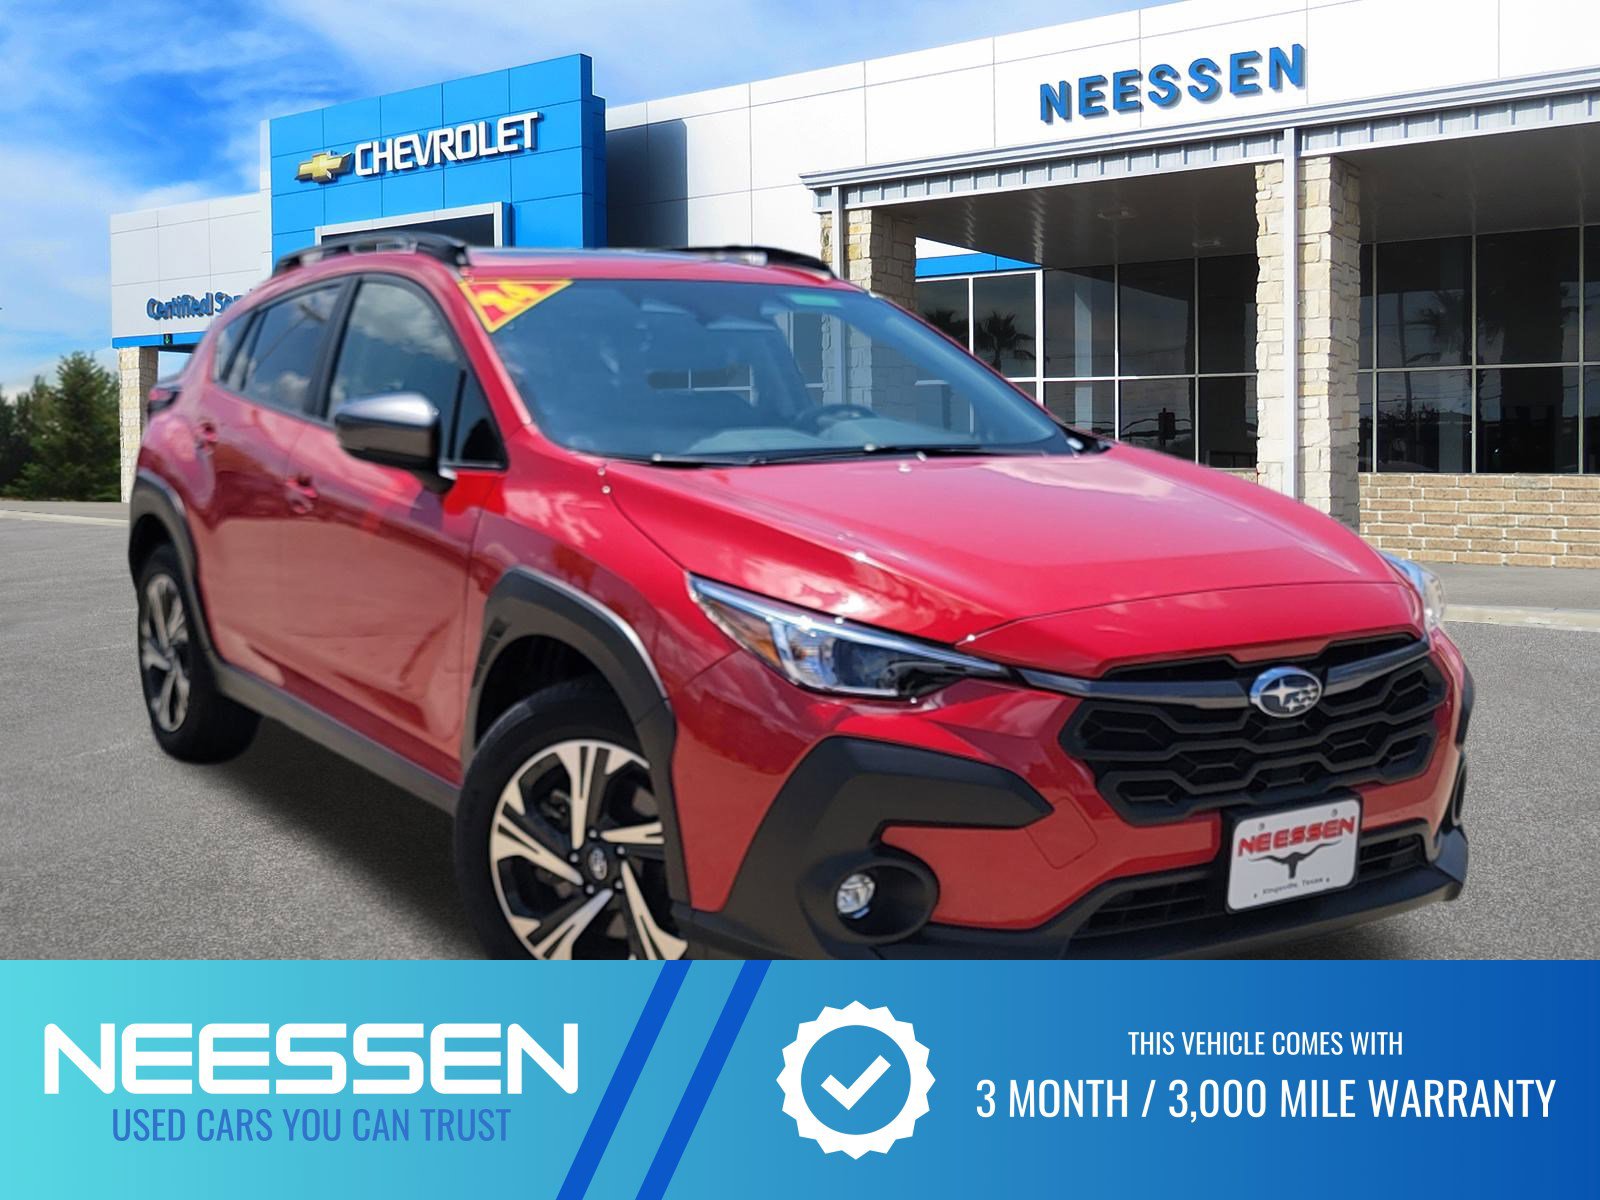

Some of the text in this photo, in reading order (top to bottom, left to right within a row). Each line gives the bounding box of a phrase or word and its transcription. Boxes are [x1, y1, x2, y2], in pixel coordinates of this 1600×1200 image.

[1040, 43, 1305, 123] NEESSEN
[354, 111, 542, 177] CHEVROLET
[147, 292, 214, 320] Certified
[1238, 815, 1355, 857] NEESSEN
